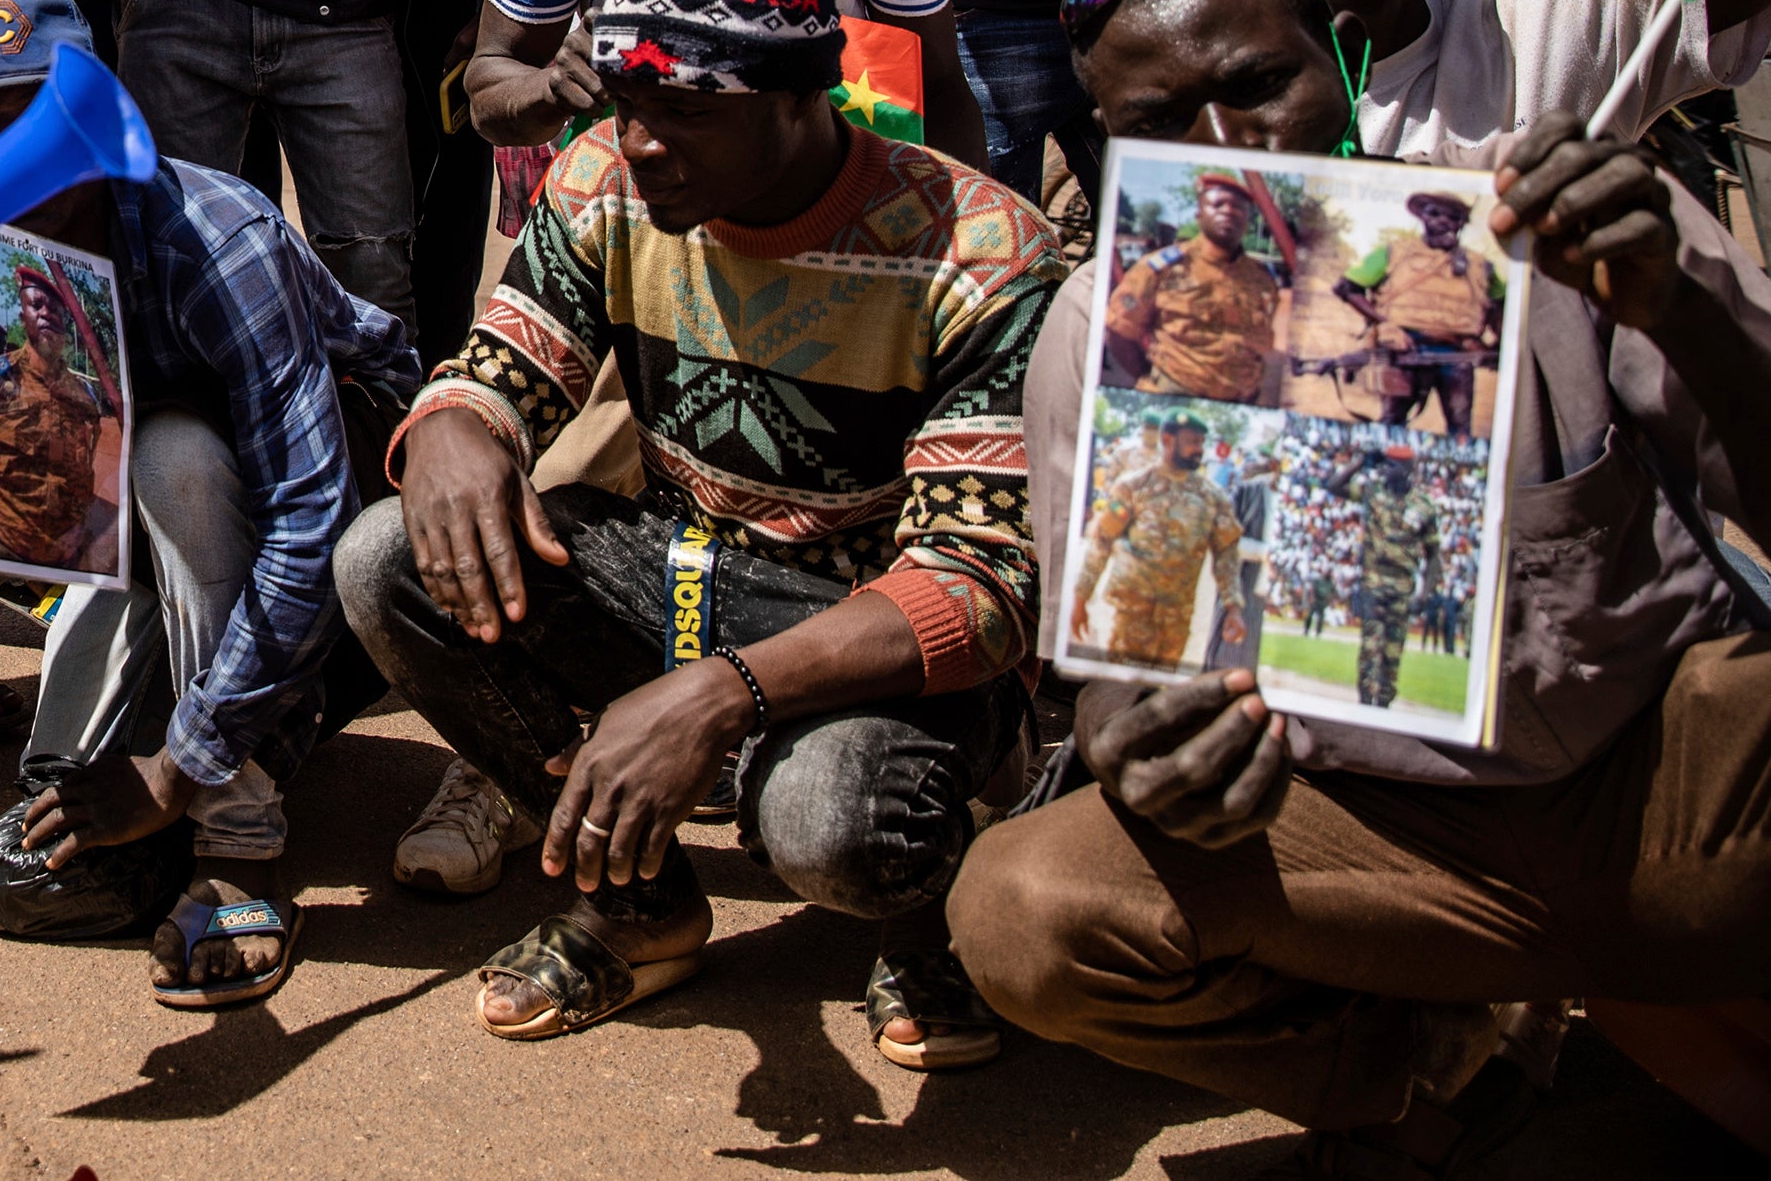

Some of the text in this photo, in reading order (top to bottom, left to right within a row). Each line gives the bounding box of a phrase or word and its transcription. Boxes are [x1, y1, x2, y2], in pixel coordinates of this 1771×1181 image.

[18, 239, 39, 254] FORT
[40, 248, 54, 259] DU
[56, 253, 94, 272] BURKINA
[216, 910, 267, 928] adidas
